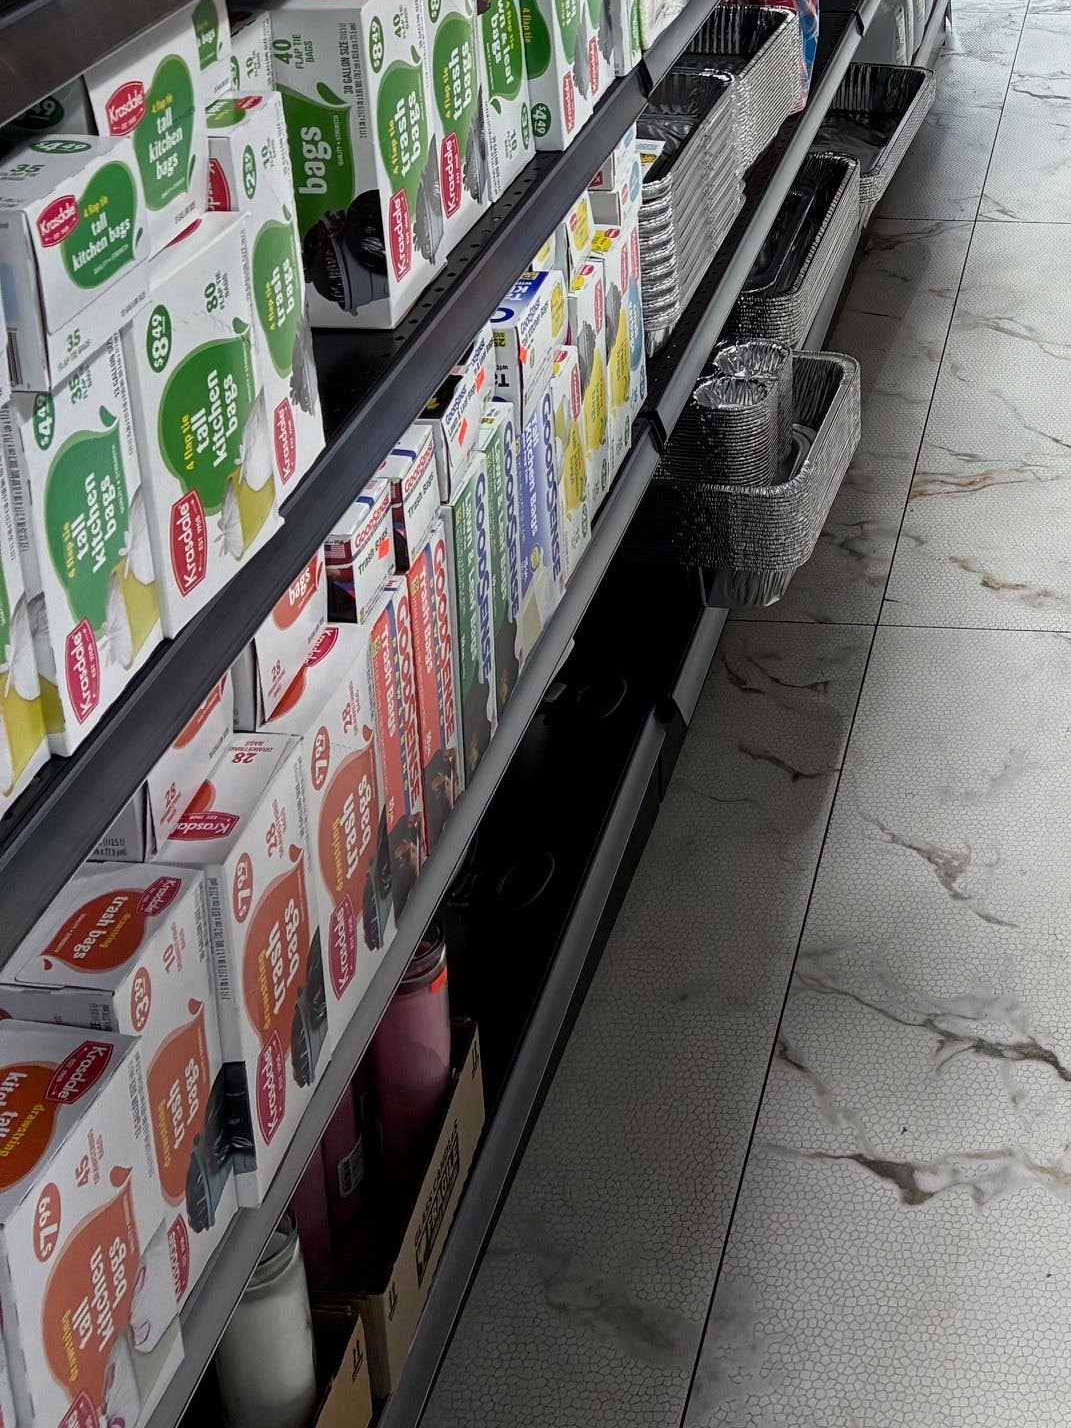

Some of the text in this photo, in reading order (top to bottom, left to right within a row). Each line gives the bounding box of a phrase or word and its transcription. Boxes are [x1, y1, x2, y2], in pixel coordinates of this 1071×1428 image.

[272, 39, 292, 65] 40
[451, 47, 463, 122] trash
[461, 42, 472, 107] bags
[149, 124, 183, 163] kitchen
[156, 107, 173, 130] tall
[395, 97, 411, 177] trash
[408, 90, 421, 162] bags
[155, 152, 179, 181] bags
[299, 126, 332, 195] bags
[72, 217, 130, 272] kitchen bags
[91, 212, 107, 235] tall
[273, 266, 286, 329] trash
[196, 407, 209, 454] tall
[208, 369, 228, 468] kitchen
[223, 373, 240, 438] bags
[72, 513, 86, 561] tall
[85, 473, 107, 574] kitchen
[101, 474, 118, 540] bags
[181, 500, 199, 589] Krasdale
[70, 632, 92, 715] Krasdale
[339, 793, 354, 880] trash
[357, 774, 371, 856] bags
[267, 916, 282, 1015] trash
[284, 897, 299, 989] bags
[334, 907, 350, 995] Krasdale
[59, 1046, 107, 1101] Krasdale
[185, 1057, 200, 1127] bags
[260, 1043, 279, 1140] Krasdale
[166, 1079, 185, 1150] trash
[90, 1244, 115, 1353] kitchen
[109, 1236, 128, 1309] bags
[73, 1296, 95, 1350] tall
